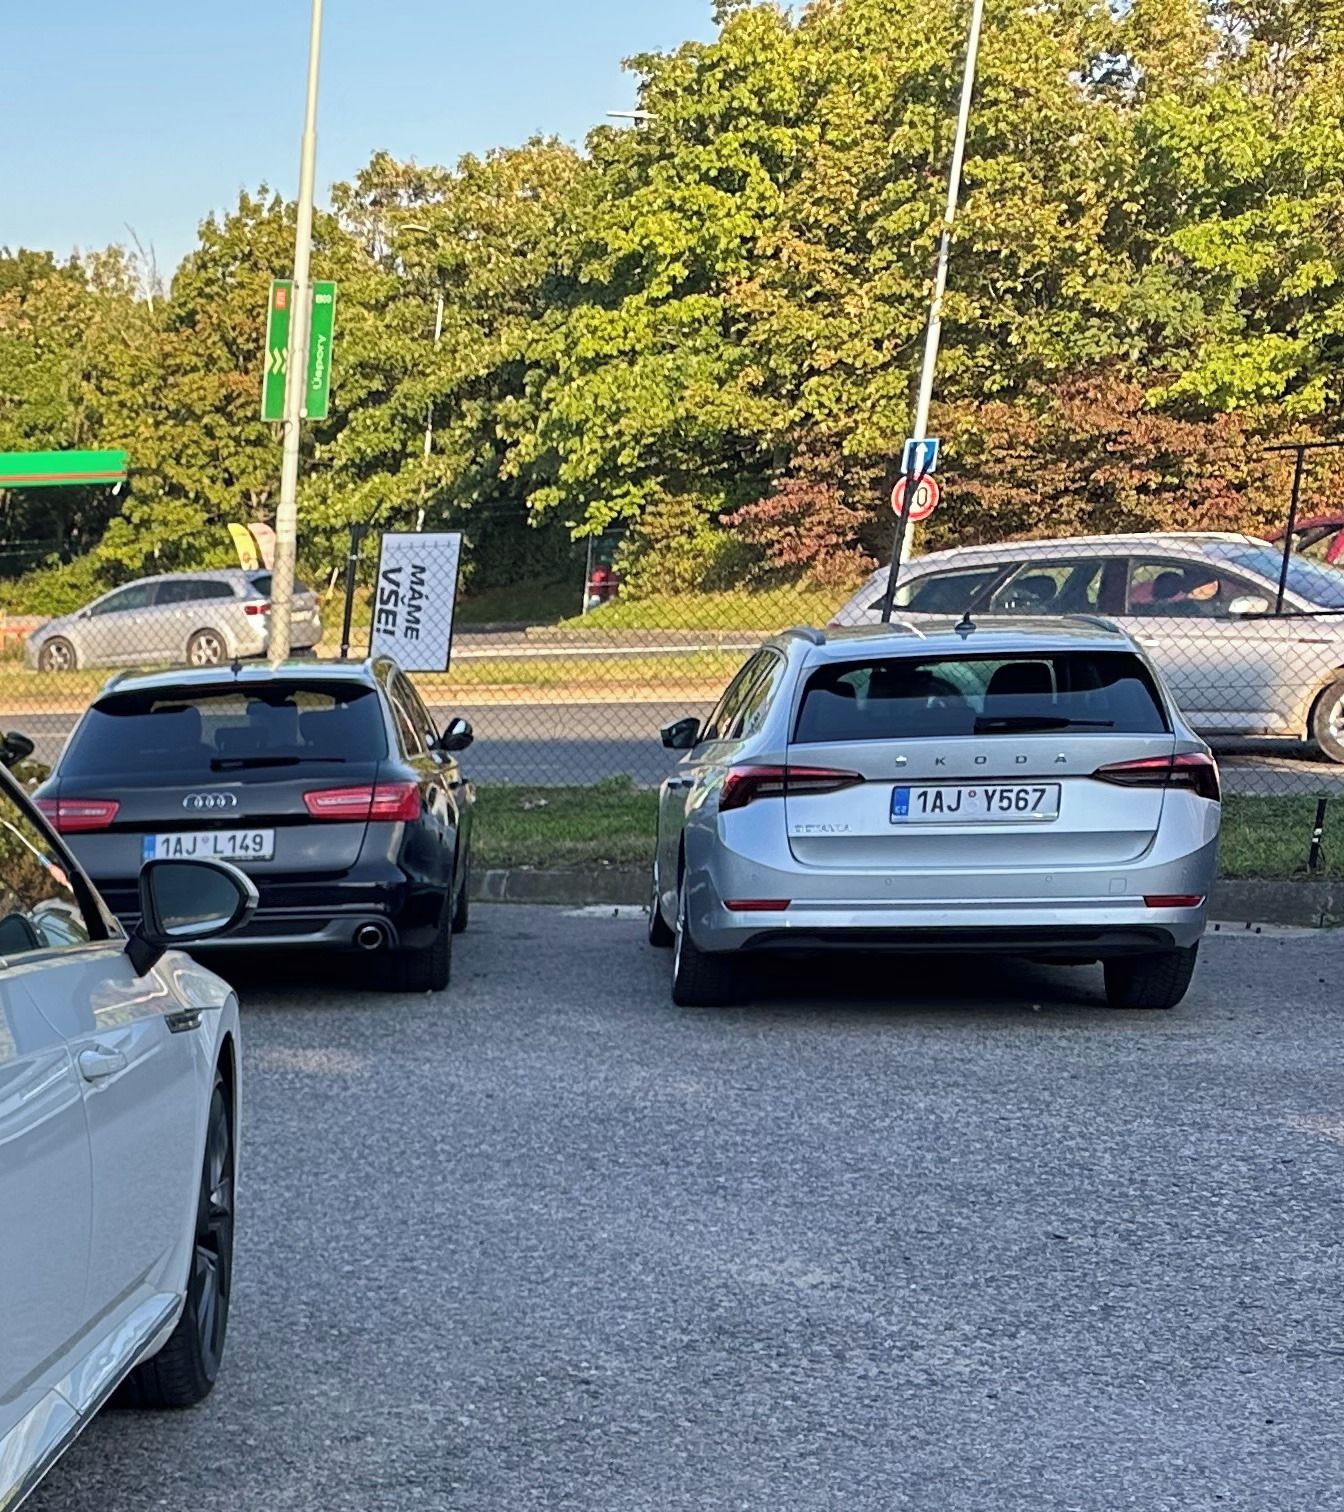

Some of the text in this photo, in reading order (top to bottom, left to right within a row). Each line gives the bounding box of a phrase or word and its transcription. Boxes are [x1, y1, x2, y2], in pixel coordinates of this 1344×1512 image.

[375, 566, 407, 637] VŠE!
[403, 564, 430, 641] MÁME
[916, 788, 962, 814] 1AJ
[983, 788, 1047, 812] Y567
[161, 833, 264, 857] 1AJ L149
